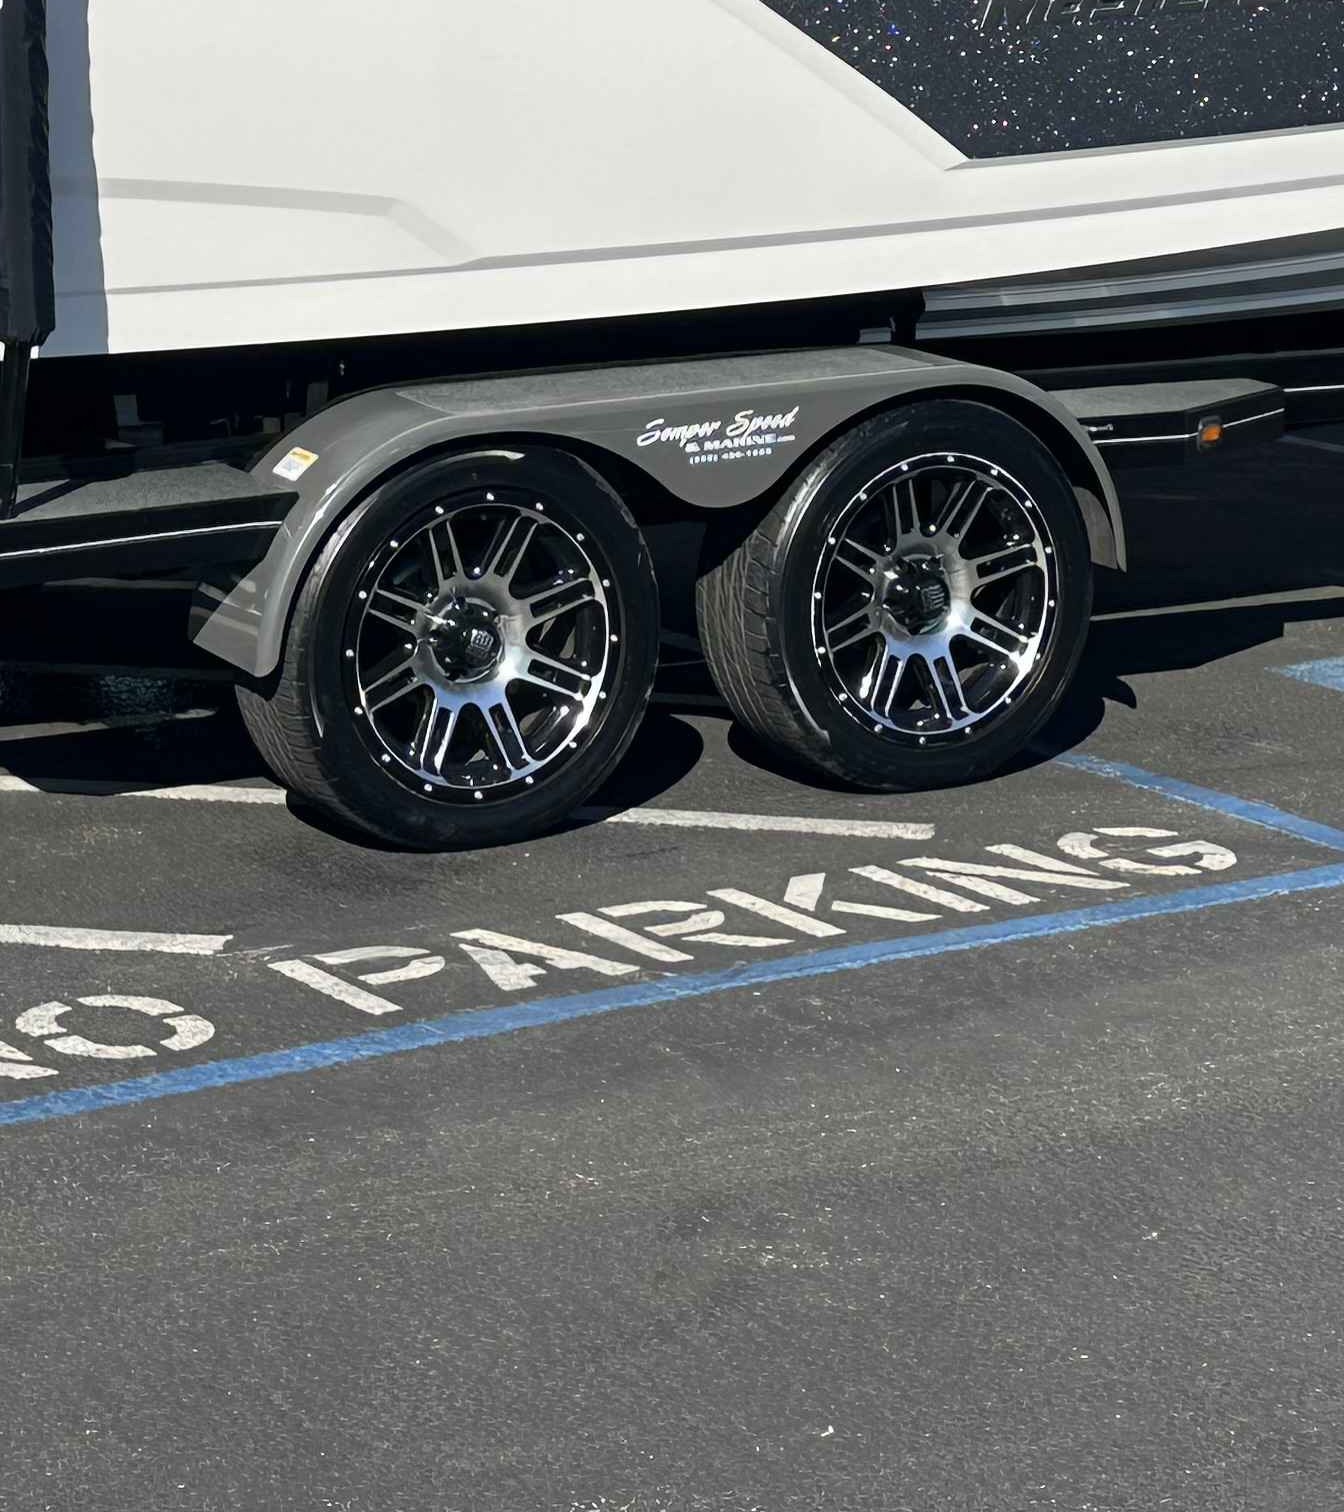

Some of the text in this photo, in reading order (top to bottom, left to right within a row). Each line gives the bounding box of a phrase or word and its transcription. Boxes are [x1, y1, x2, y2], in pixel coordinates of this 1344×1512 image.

[636, 405, 800, 447] Semper Speed
[267, 826, 1238, 1015] PARKING
